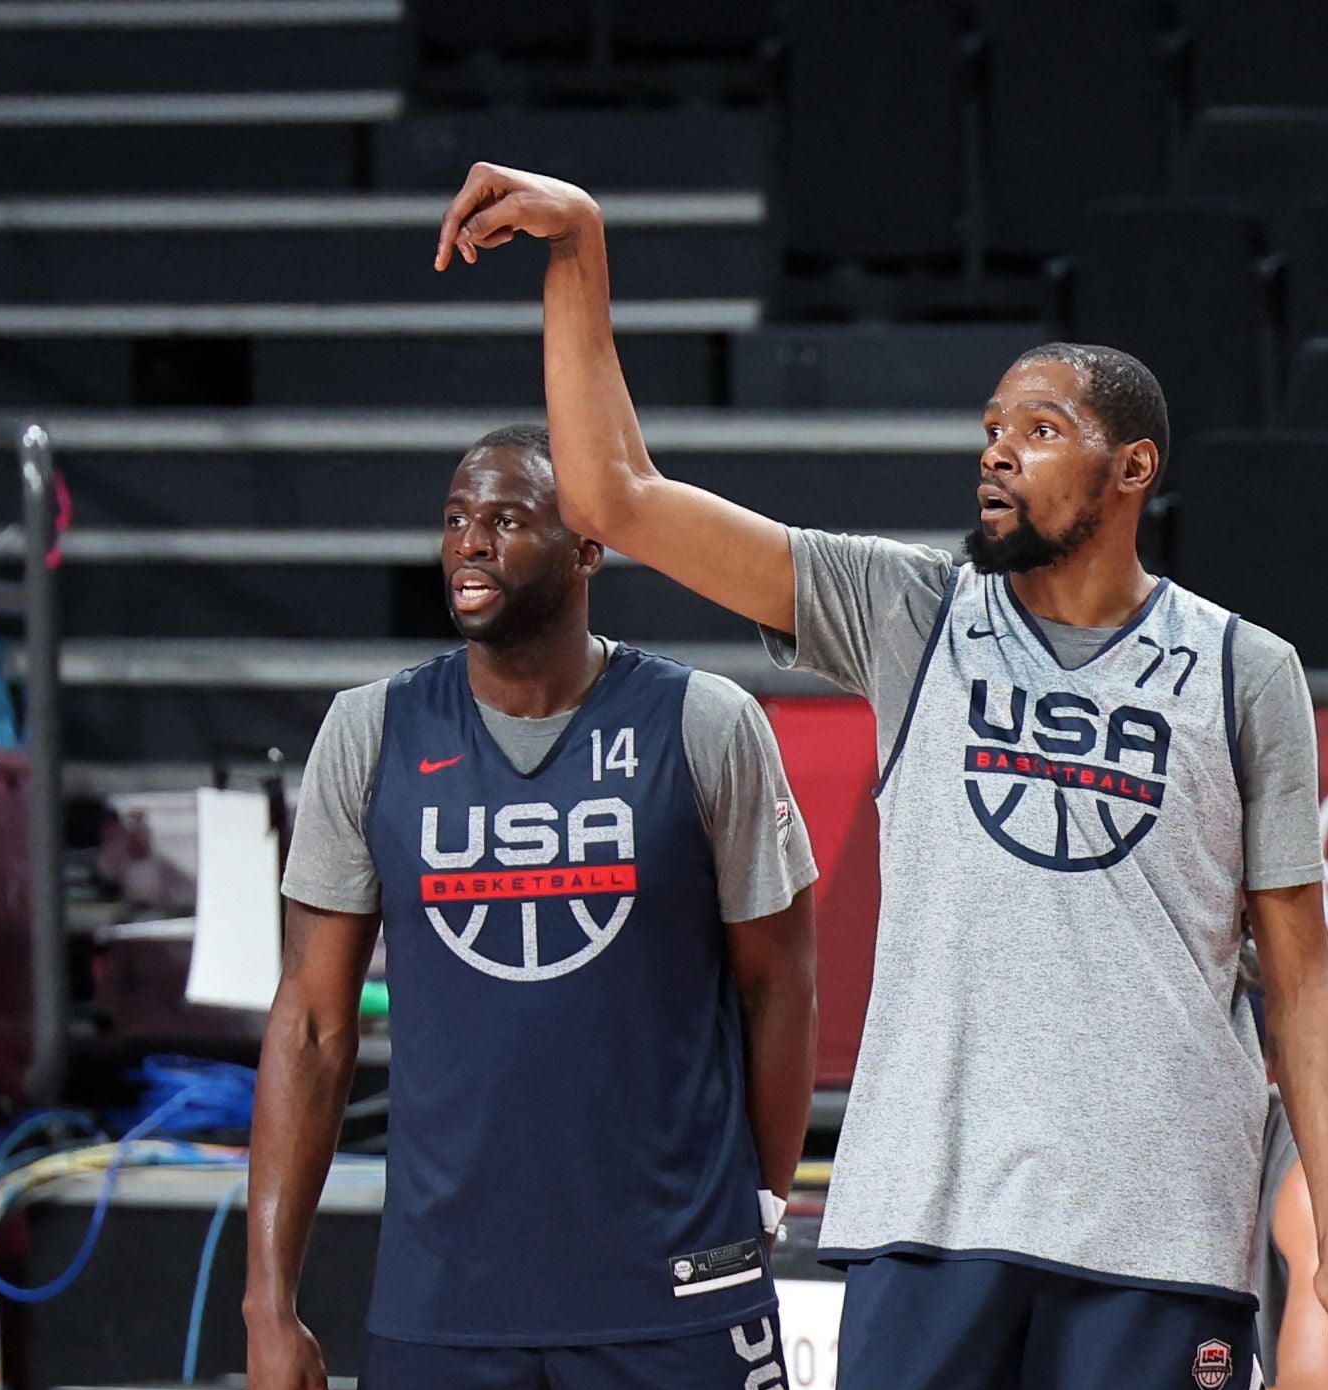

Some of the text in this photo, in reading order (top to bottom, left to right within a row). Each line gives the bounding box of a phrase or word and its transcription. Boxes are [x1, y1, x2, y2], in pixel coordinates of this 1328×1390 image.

[1138, 635, 1198, 696] 77
[590, 727, 639, 782] 14
[968, 679, 1172, 777] USA
[420, 797, 635, 870] USA
[433, 872, 622, 894] BASKETBALL
